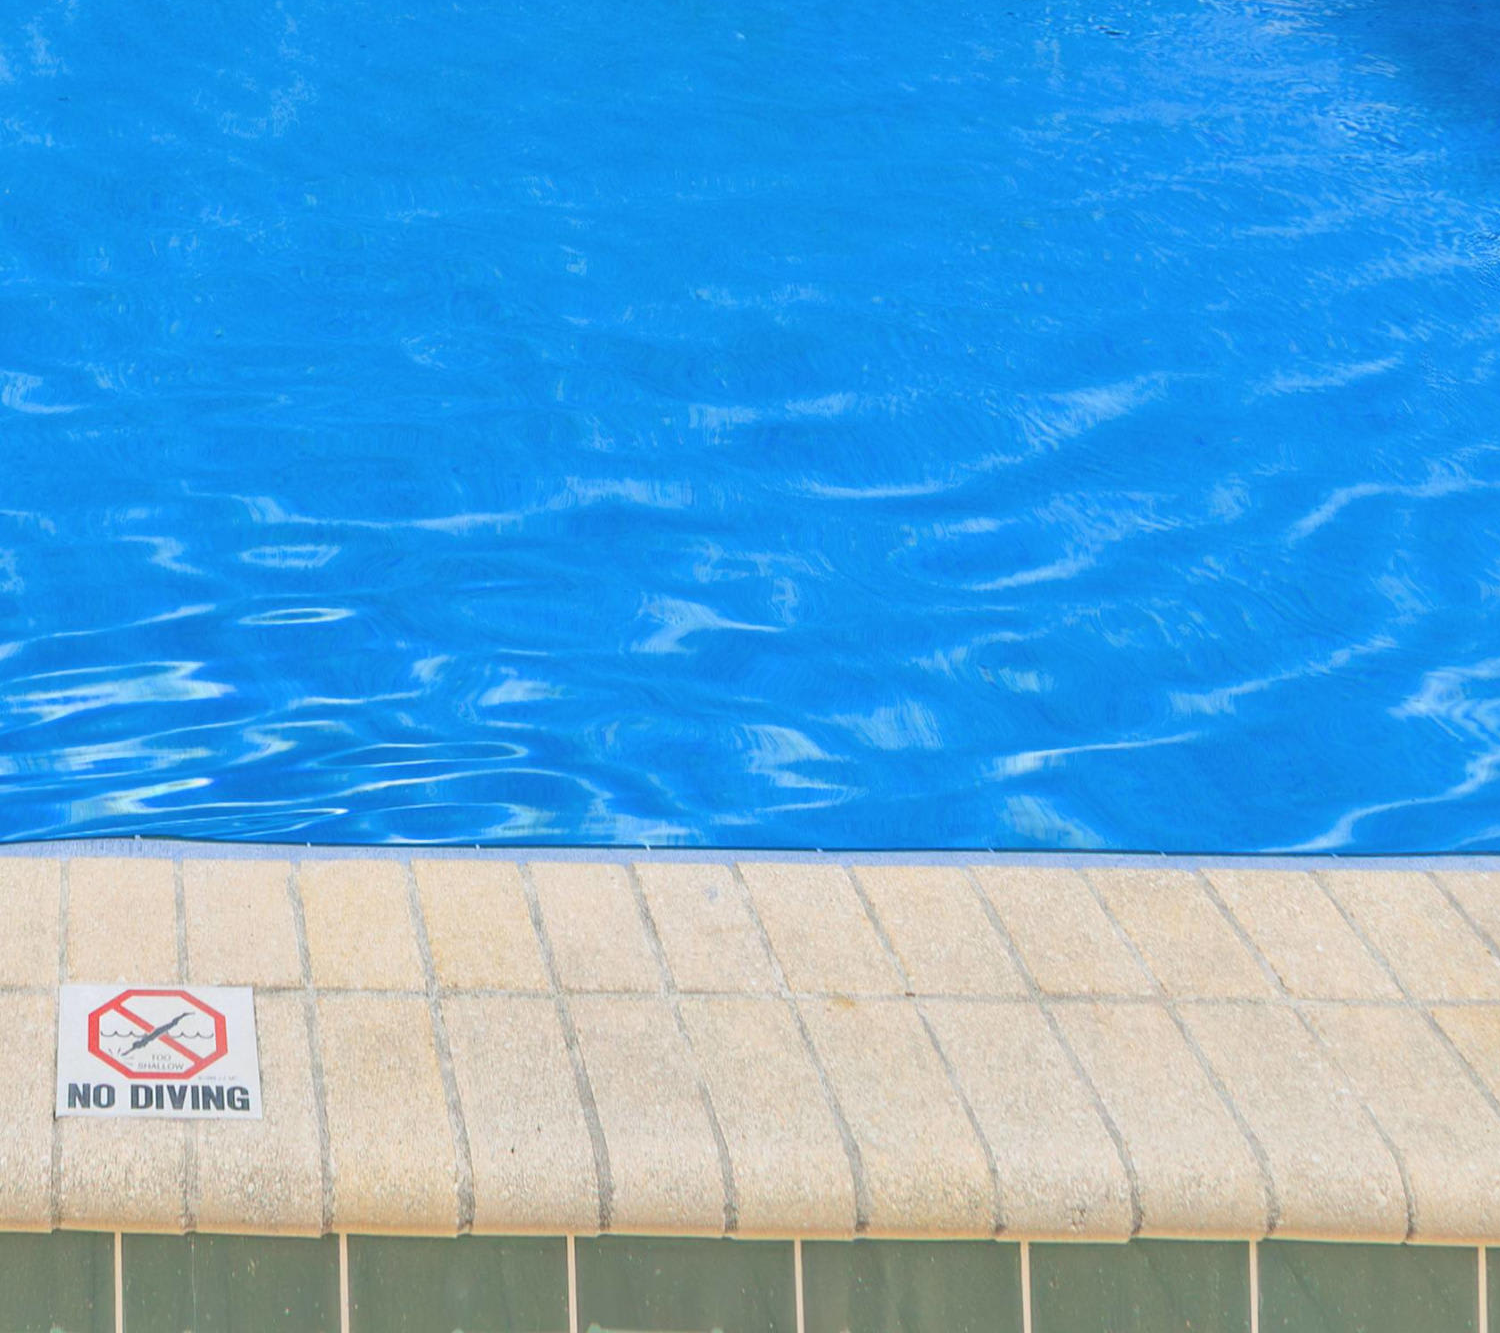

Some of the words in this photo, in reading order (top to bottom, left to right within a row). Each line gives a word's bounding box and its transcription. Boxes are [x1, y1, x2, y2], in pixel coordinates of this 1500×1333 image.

[137, 1062, 184, 1070] SHALLOW
[67, 1083, 116, 1109] NO
[130, 1084, 251, 1111] DIVING
